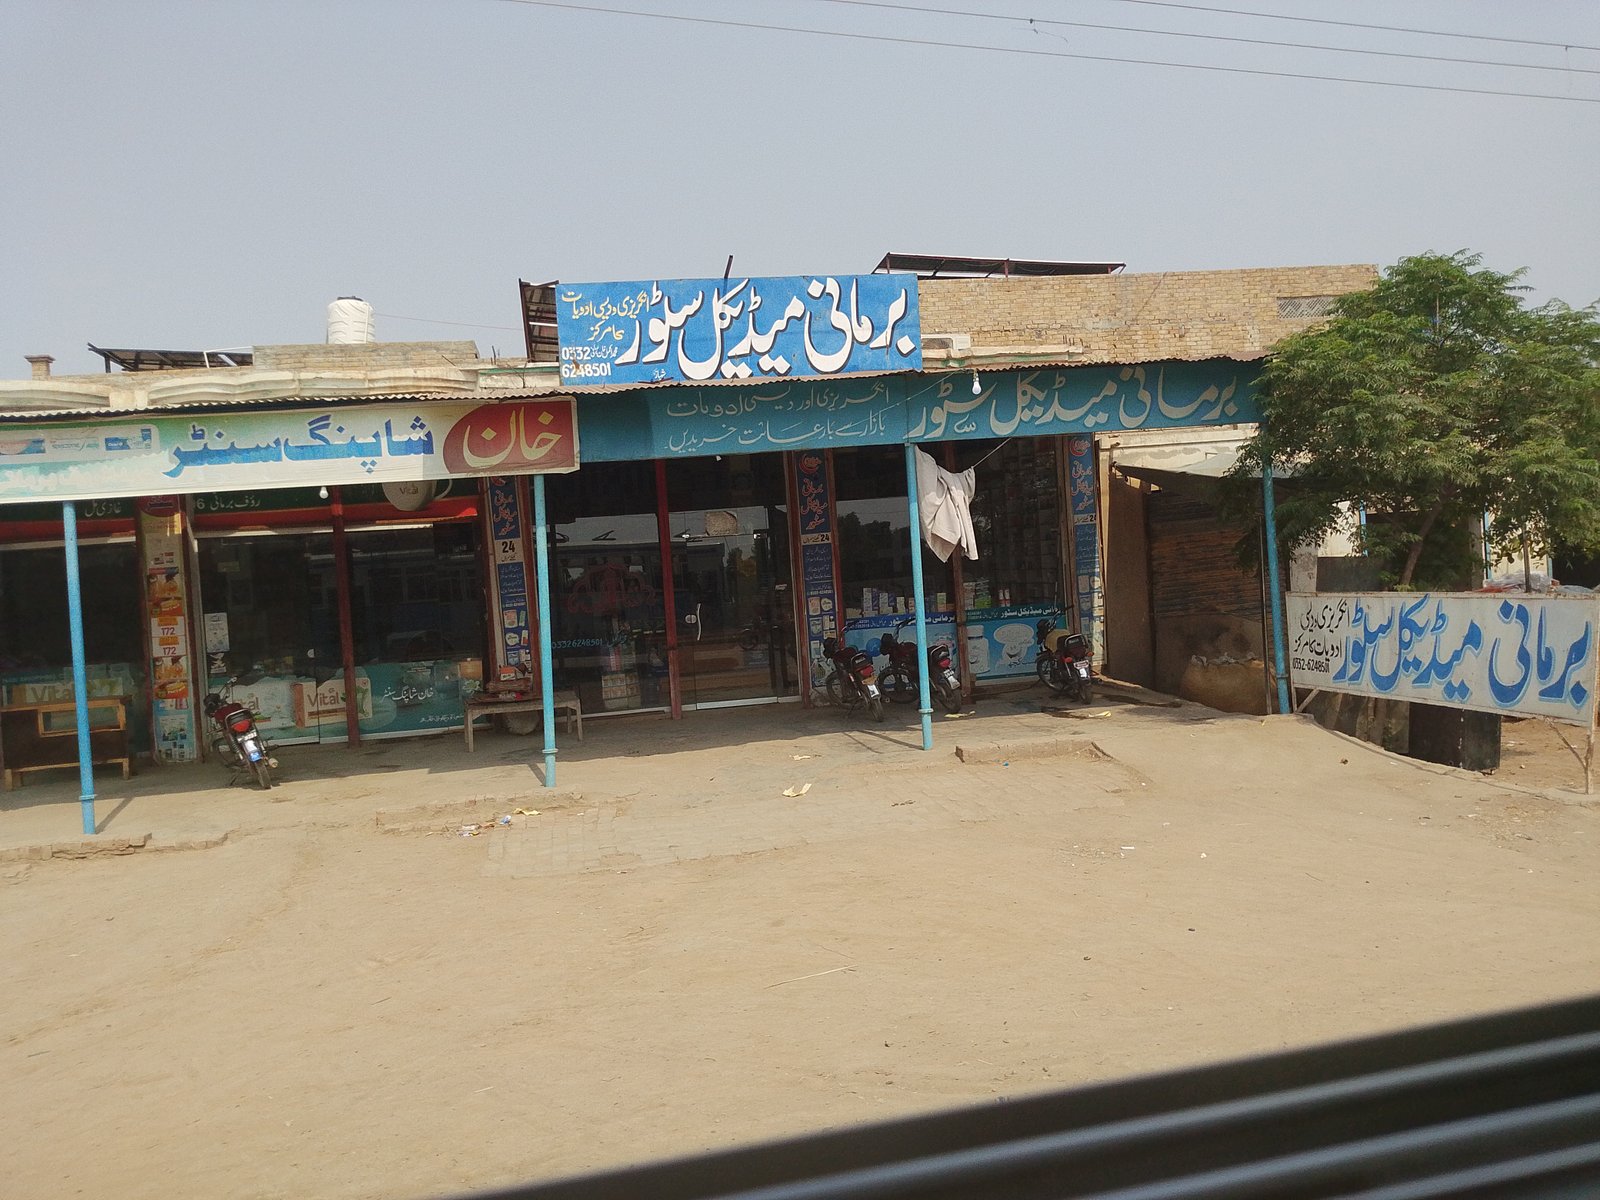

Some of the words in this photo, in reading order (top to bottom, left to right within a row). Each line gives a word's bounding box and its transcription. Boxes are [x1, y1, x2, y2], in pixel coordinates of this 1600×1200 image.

[561, 346, 591, 360] 0332
[614, 281, 703, 364] سٹور
[678, 278, 805, 380] میڈیکل
[804, 277, 917, 374] برمانی
[561, 362, 611, 378] 6248501
[1119, 366, 1238, 430] برمانی
[989, 369, 1118, 437] میڈیکل
[283, 413, 436, 476] شاپنگ
[461, 405, 563, 469] خان
[501, 540, 515, 553] 24
[161, 627, 176, 635] 172
[163, 647, 177, 655] 172
[1332, 597, 1394, 684] سٹور
[1371, 593, 1482, 704] میڈیکل
[1488, 598, 1591, 708] برمانی
[307, 691, 340, 707] Vital
